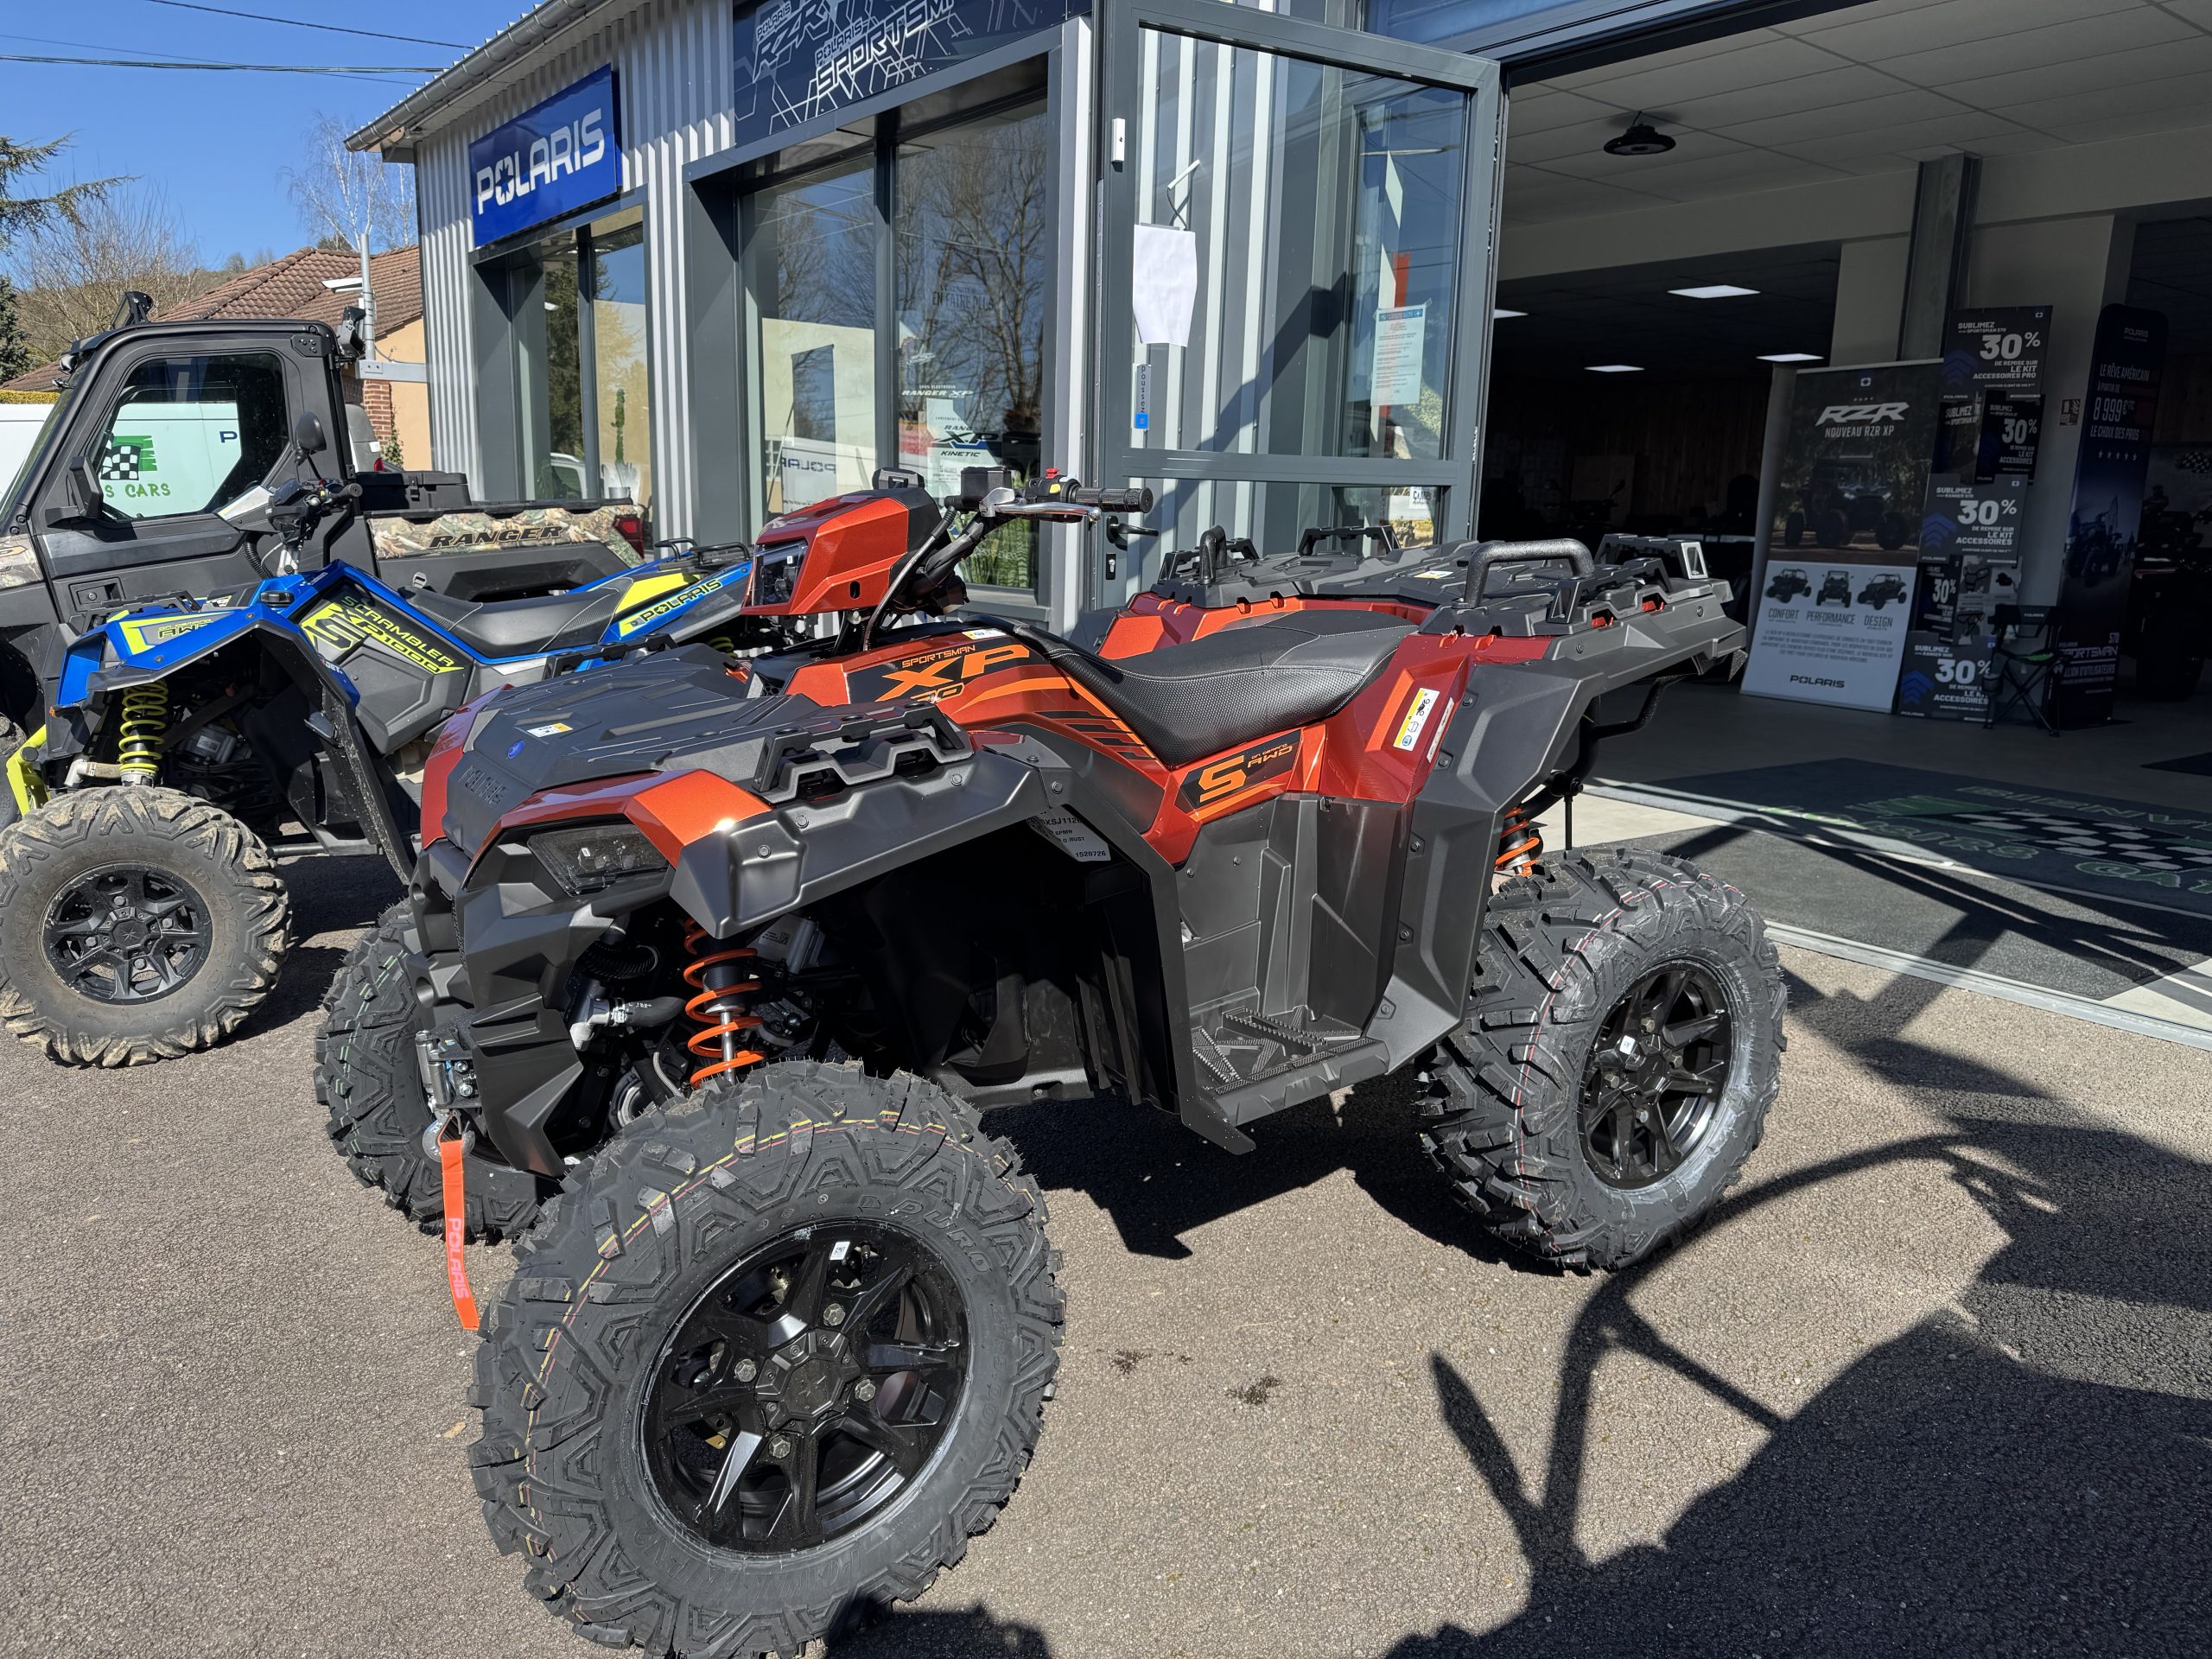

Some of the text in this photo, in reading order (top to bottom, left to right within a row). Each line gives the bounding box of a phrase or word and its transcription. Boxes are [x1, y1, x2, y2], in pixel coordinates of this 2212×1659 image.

[476, 107, 605, 215] POLARIS
[1980, 332, 2040, 359] 30%
[1815, 402, 1910, 427] RZR
[1825, 425, 1894, 438] NOUVEAU RZR XP
[2002, 418, 2037, 444] 30%
[124, 483, 171, 498] CARS
[1957, 499, 2017, 525] 30%
[430, 525, 564, 549] RANGER
[641, 579, 722, 623] POLARIS
[1932, 578, 1956, 603] 30%
[1768, 608, 1893, 627] CONFORT PERFORMANCE DESIGN
[340, 596, 454, 667] SCRAMBLER
[902, 645, 976, 668] SPORTSMAN
[1915, 645, 1949, 653] SUBLIMEZ
[874, 644, 1030, 702] XP
[1790, 675, 1845, 688] POLARIS
[448, 1217, 470, 1300] POLARIS
